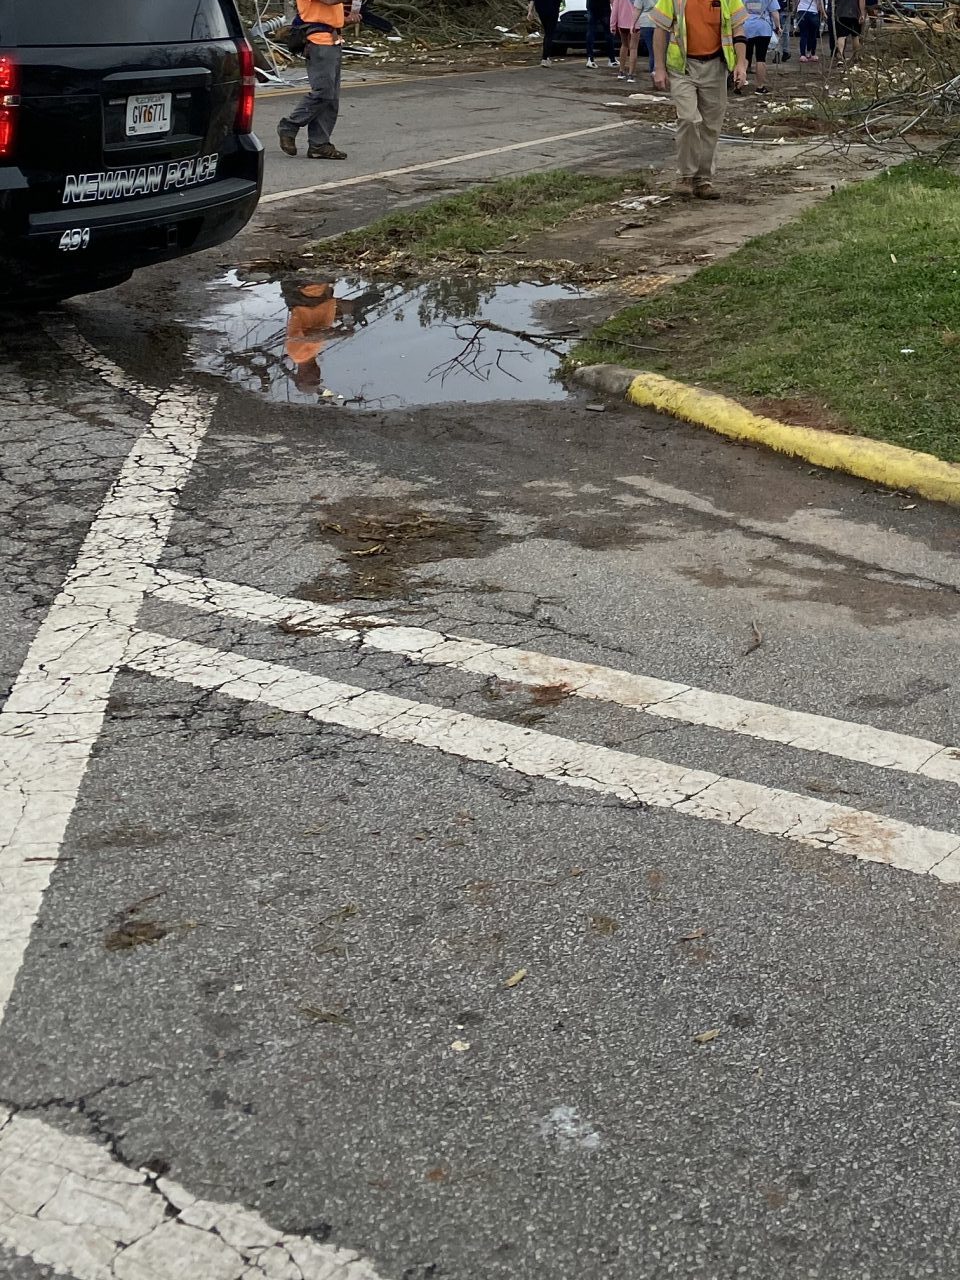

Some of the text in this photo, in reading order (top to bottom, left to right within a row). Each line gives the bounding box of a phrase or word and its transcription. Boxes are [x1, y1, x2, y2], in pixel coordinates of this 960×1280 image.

[133, 103, 168, 124] GV7677L
[62, 152, 219, 204] NEWNAN POLICE
